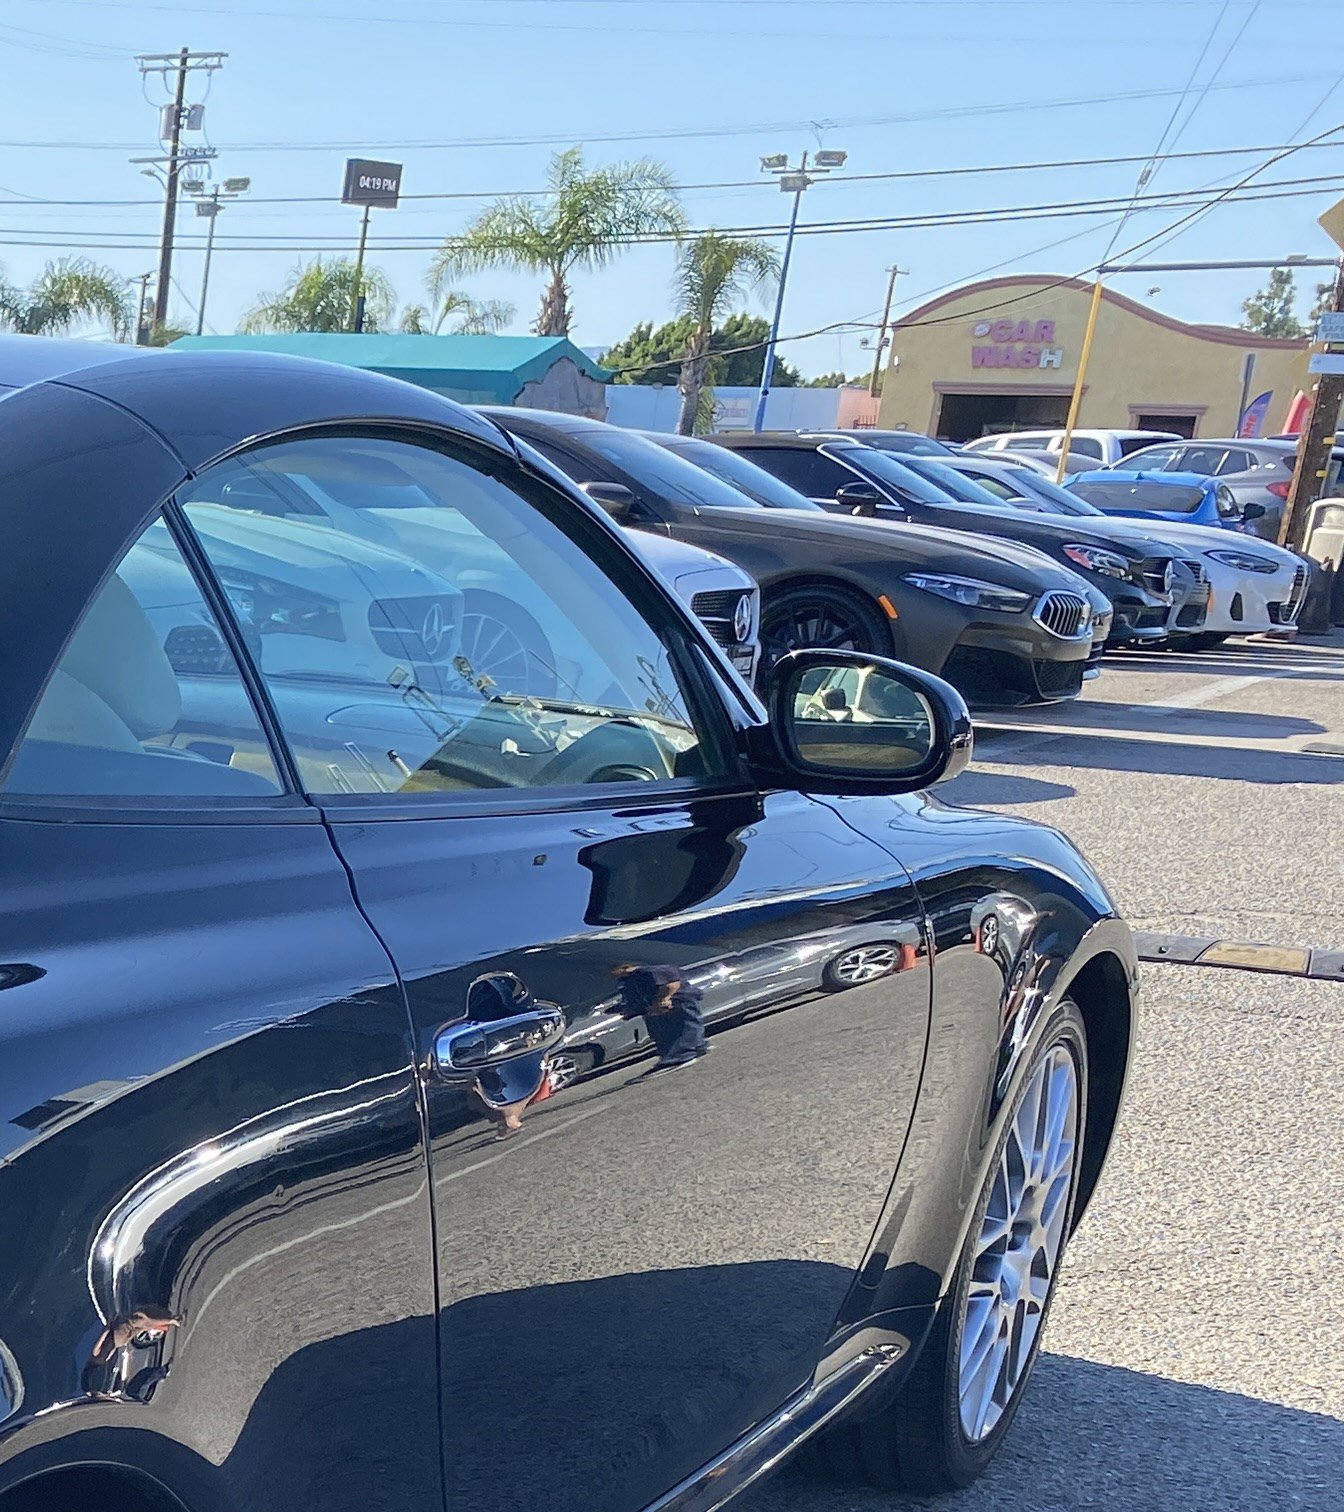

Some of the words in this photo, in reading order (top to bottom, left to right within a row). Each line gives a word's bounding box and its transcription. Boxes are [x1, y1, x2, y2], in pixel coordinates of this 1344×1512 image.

[359, 175, 381, 190] 04:19
[382, 178, 397, 192] PM
[991, 319, 1056, 343] CAR
[971, 345, 1064, 369] WASH
